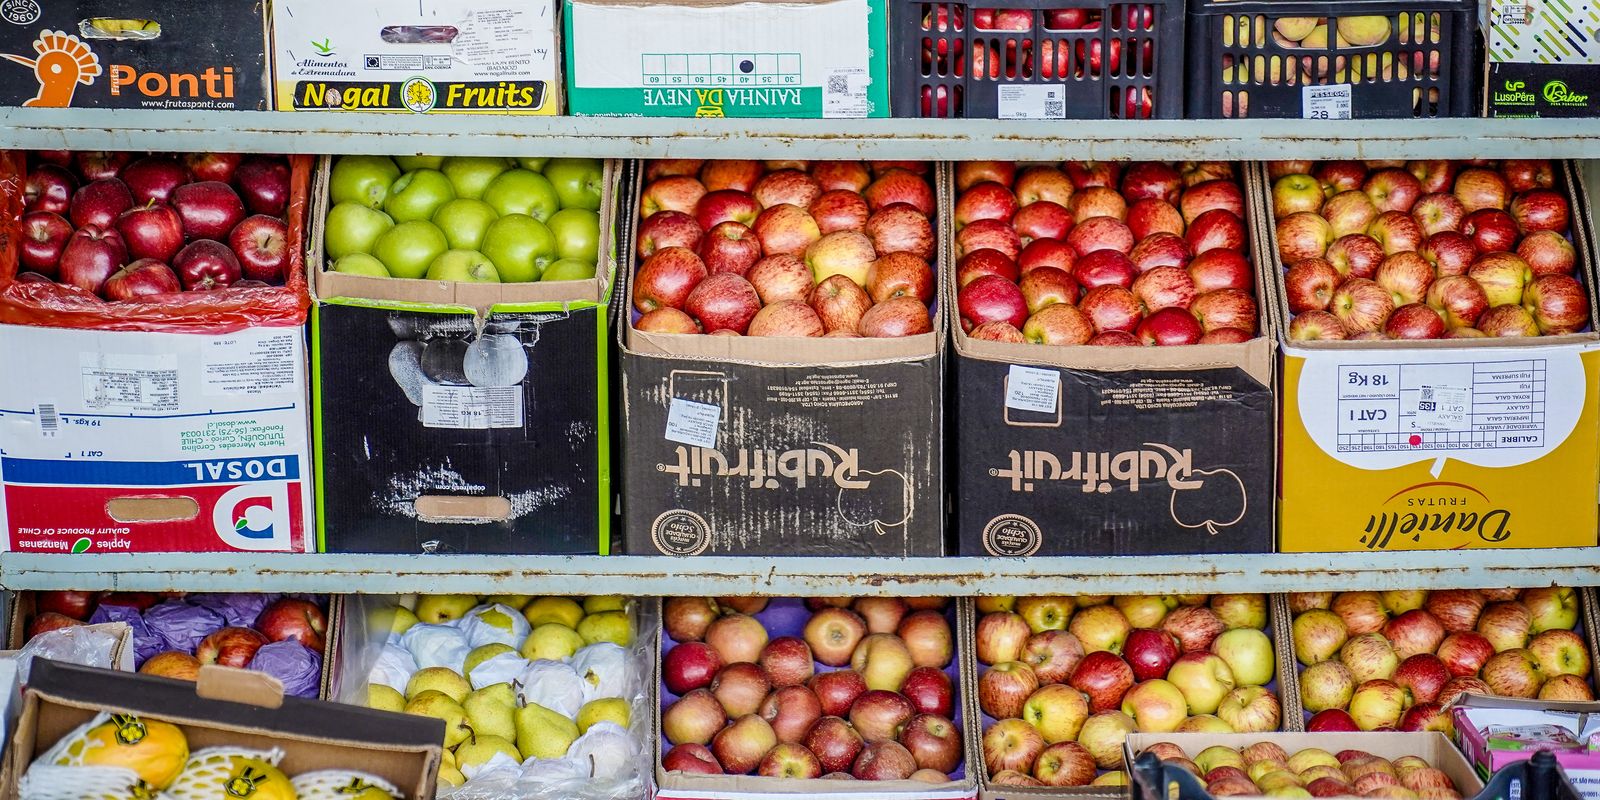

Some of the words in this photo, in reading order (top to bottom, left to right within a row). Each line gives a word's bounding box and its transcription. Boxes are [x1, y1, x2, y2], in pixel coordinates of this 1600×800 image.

[6, 0, 36, 10] SINCE
[8, 12, 34, 22] 1960
[296, 59, 348, 68] Alimentos
[110, 64, 234, 98] Ponti
[111, 64, 120, 93] Frutas
[446, 82, 534, 107] Fruits
[643, 89, 692, 106] NEVE
[695, 88, 723, 105] DA
[725, 89, 801, 105] RAINHA
[1494, 92, 1535, 102] LusoPêra
[1554, 91, 1588, 102] Sabor
[141, 100, 234, 109] www.frutasponti.com
[1311, 111, 1328, 119] 28
[1349, 372, 1368, 386] Kg
[1372, 375, 1389, 386] 18
[1351, 410, 1353, 420] I
[1358, 409, 1387, 420] CAT
[73, 418, 89, 426] kgs.
[207, 420, 256, 429] www.dosal.cl
[188, 458, 286, 481] DOSAL
[664, 441, 870, 489] Rubifruit
[999, 442, 1204, 493] Rubifruit
[1408, 497, 1466, 507] FRUTAS
[1002, 528, 1026, 538] Schio
[1359, 509, 1511, 549] Danielli
[19, 540, 68, 550] Manzanas
[97, 540, 131, 550] Apples
